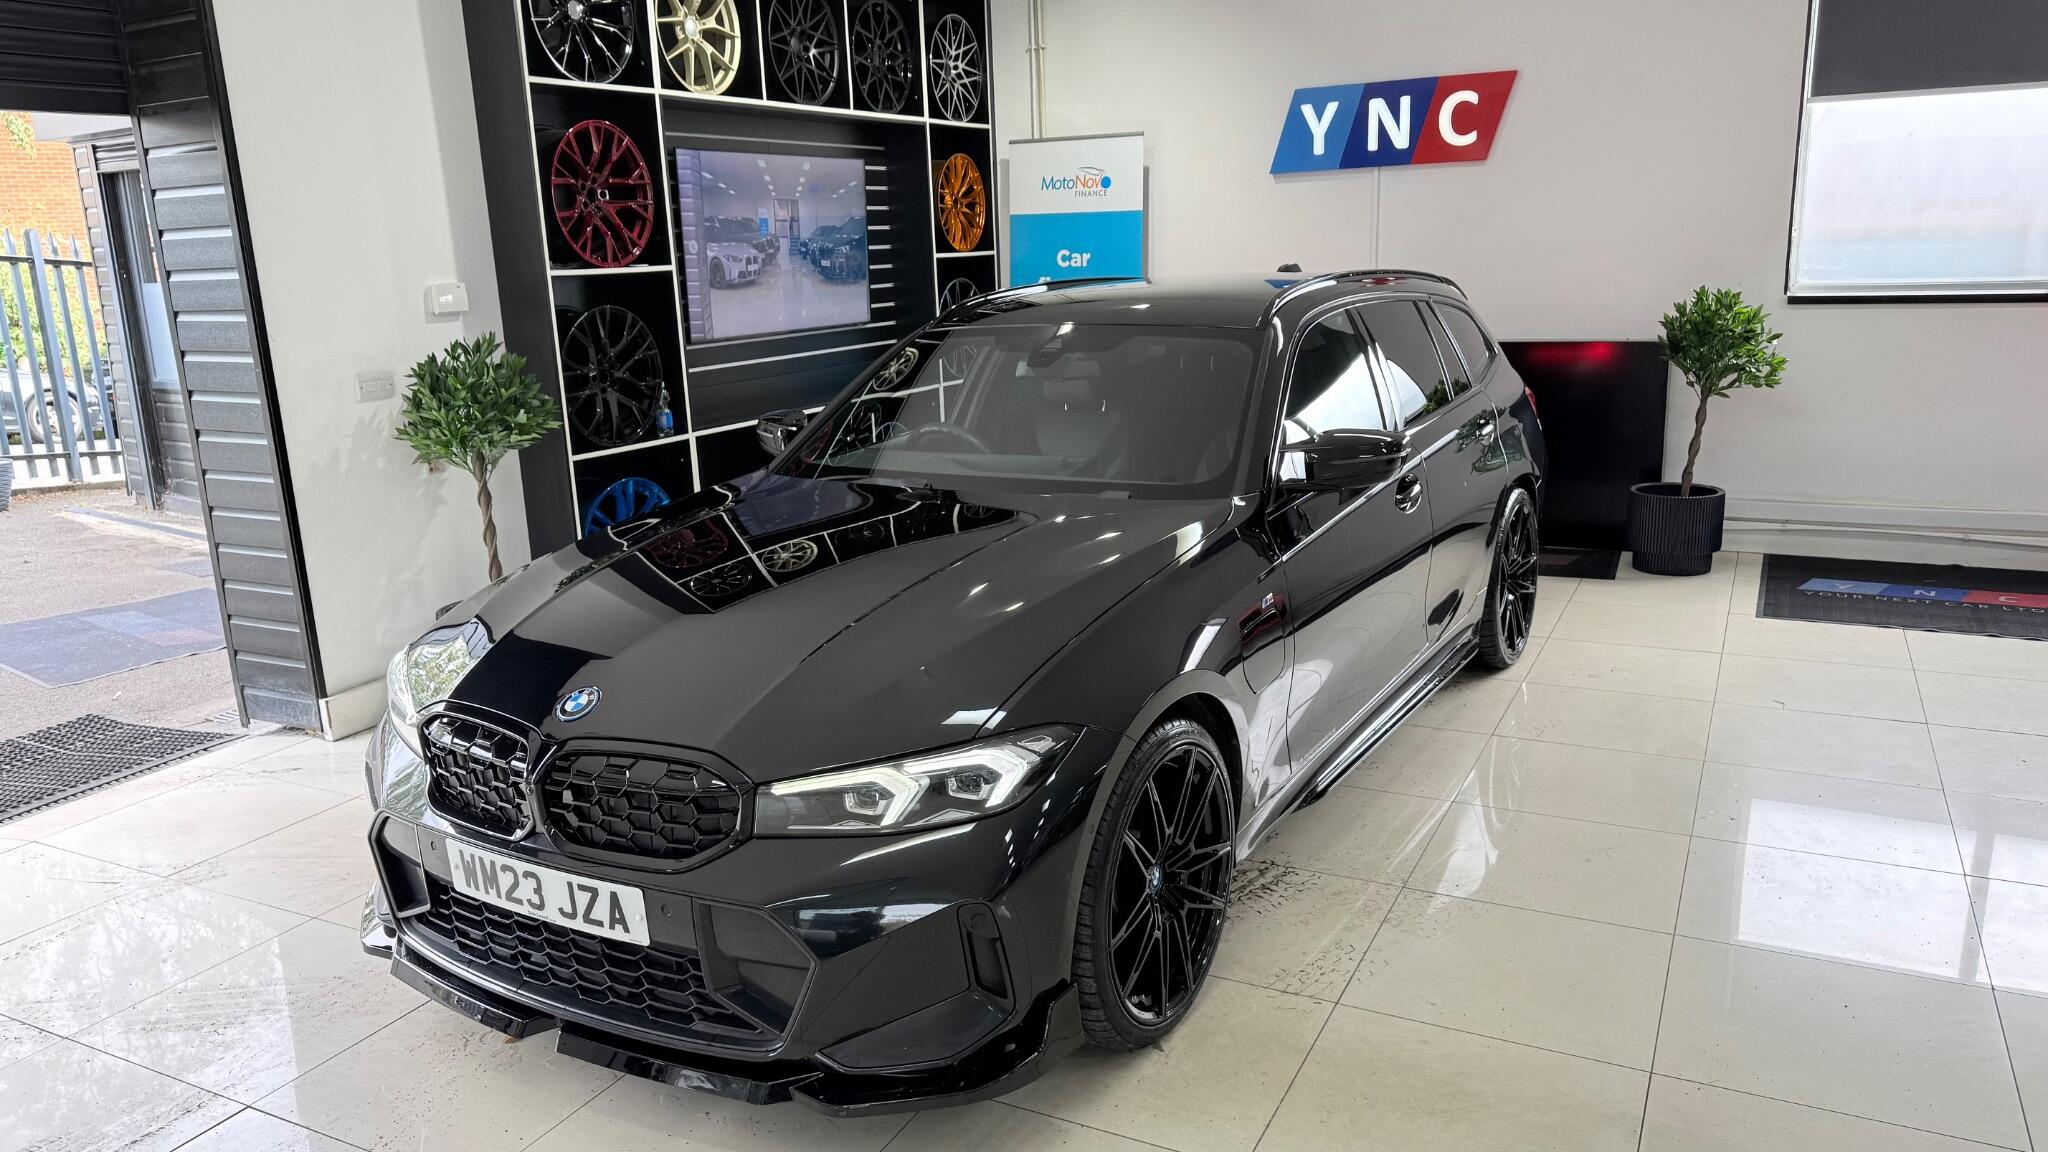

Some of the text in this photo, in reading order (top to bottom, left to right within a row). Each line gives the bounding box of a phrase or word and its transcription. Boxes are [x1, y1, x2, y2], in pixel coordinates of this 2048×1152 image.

[1300, 89, 1479, 156] YNC
[1041, 173, 1112, 191] MotoNovo
[1074, 190, 1108, 198] FINANCE
[1056, 249, 1091, 268] Car
[1804, 590, 1863, 599] YOUR
[1875, 595, 1932, 605] NEXT
[1944, 601, 1989, 609] CAR
[458, 849, 631, 934] WM23 JZA
